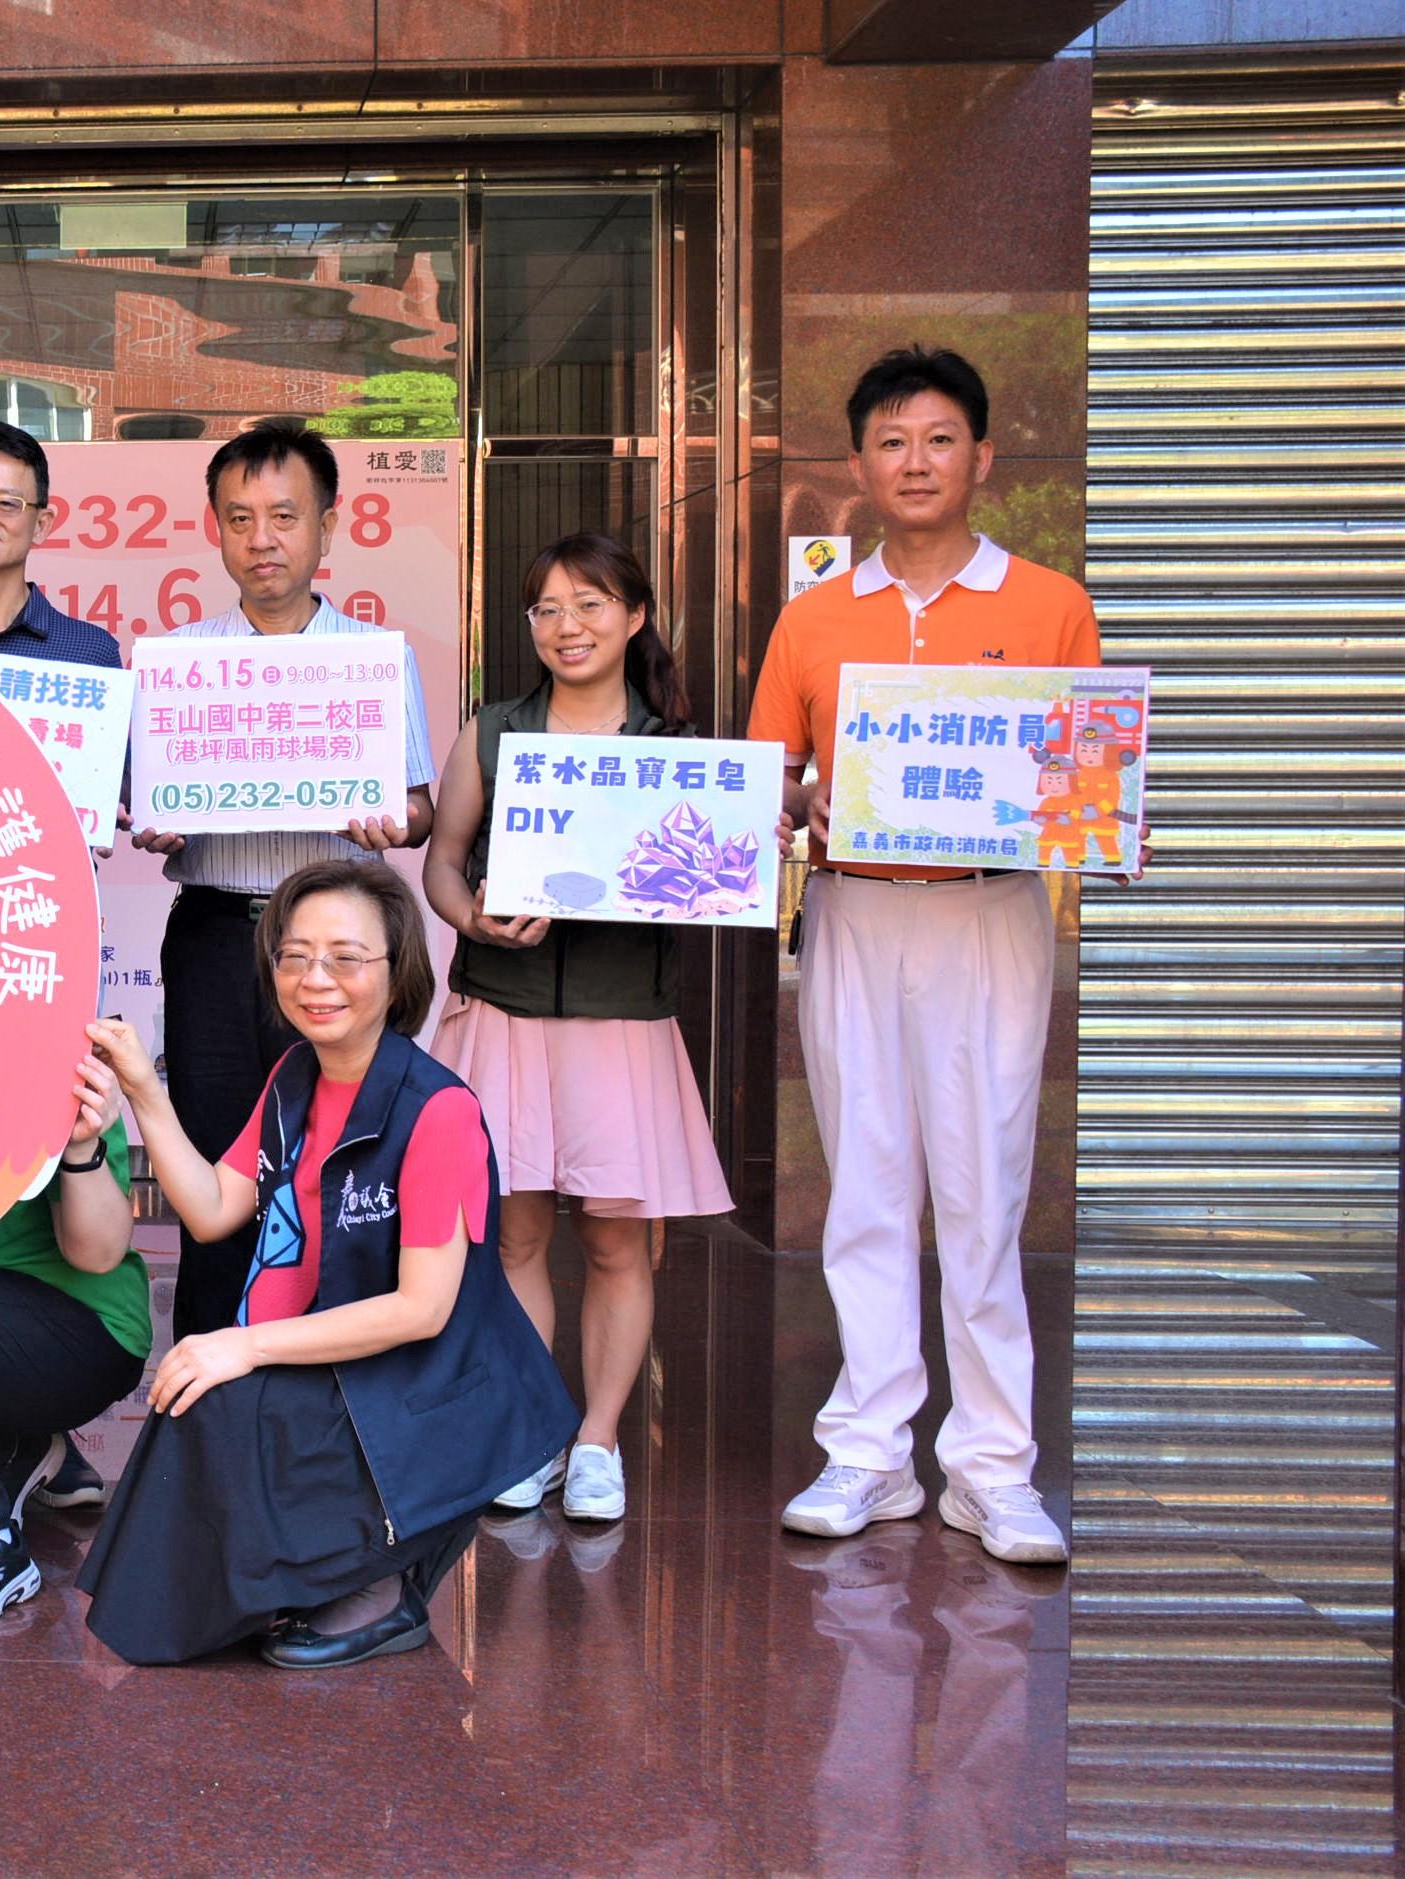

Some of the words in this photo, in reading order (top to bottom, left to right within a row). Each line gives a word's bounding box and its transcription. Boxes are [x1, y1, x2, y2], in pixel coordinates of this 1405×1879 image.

[366, 450, 418, 471] 植愛
[138, 658, 255, 691] 114.6.15
[287, 662, 399, 684] 9:00~13:00
[148, 699, 385, 736] 玉山國中第二校區
[845, 712, 1046, 749] 小小消防員
[166, 734, 364, 765] (港坪風雨球場旁)
[514, 753, 746, 792] 紫水晶寶石皂
[902, 765, 984, 801] 體驗
[151, 779, 384, 813] (05)232-0578
[506, 806, 575, 834] DIY
[852, 832, 1018, 857] 嘉義市政府消防局
